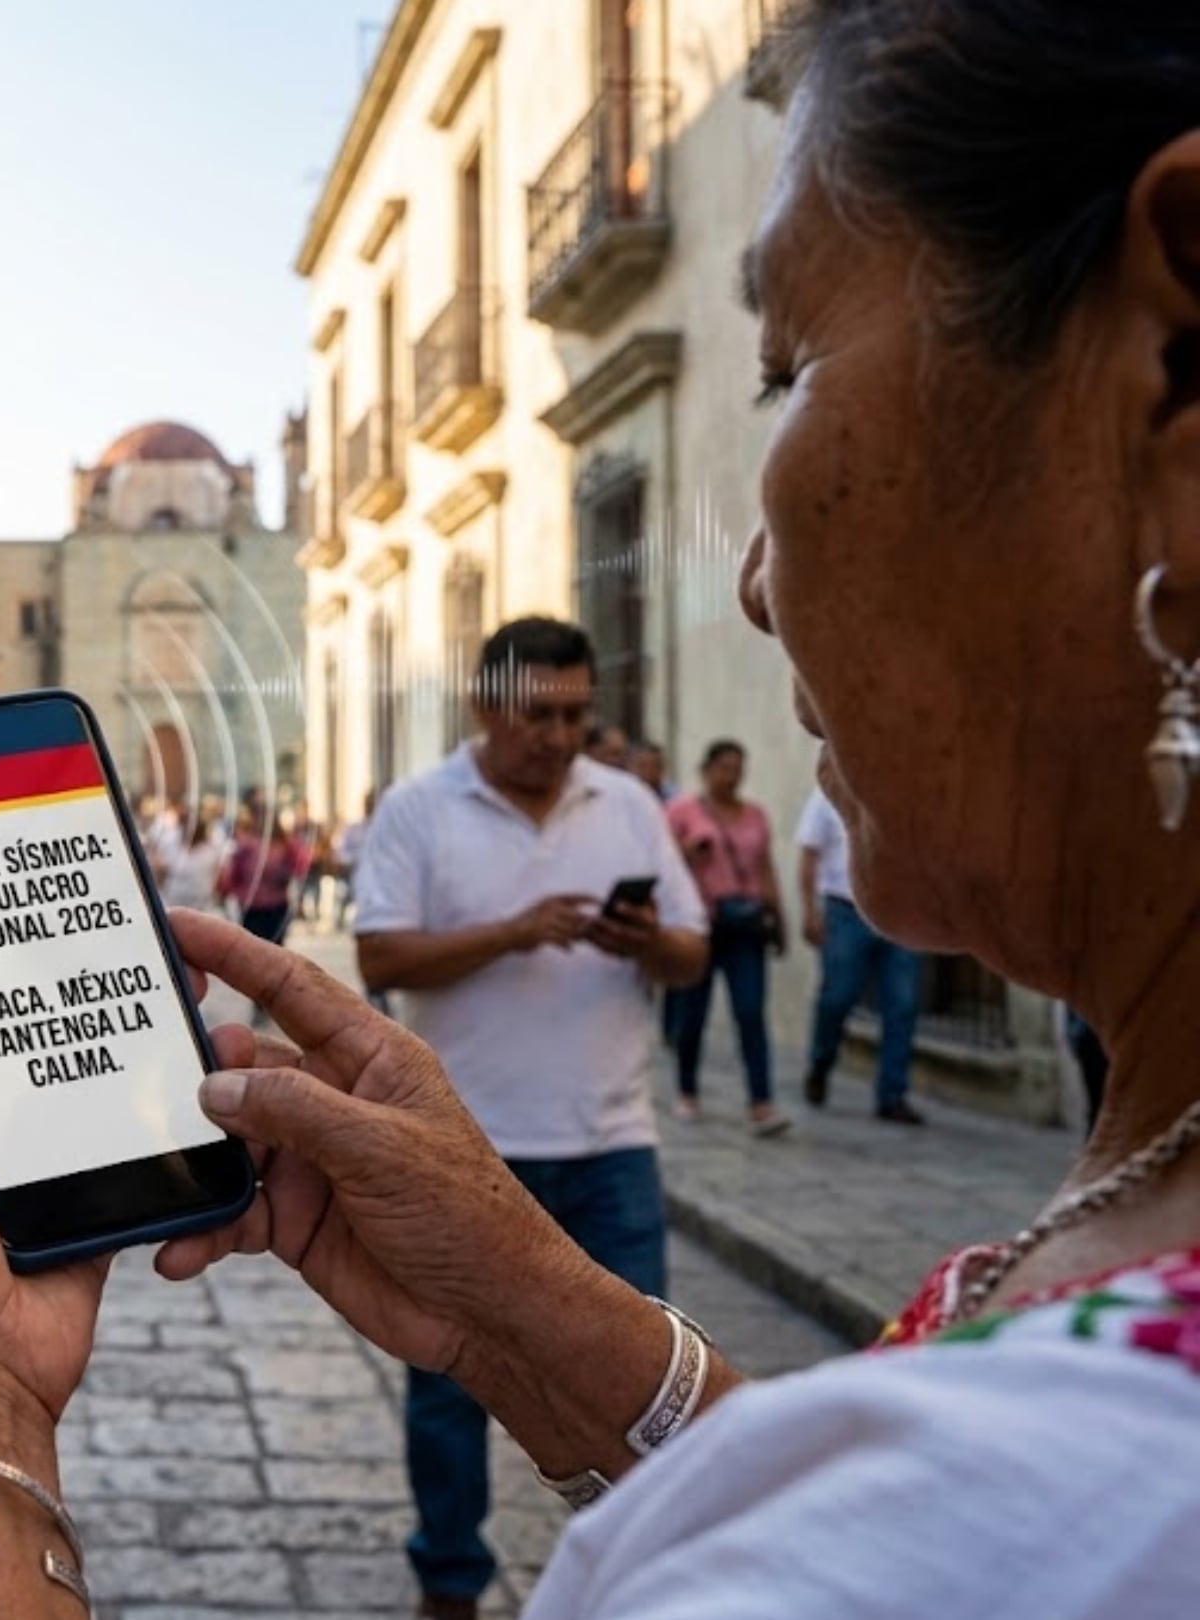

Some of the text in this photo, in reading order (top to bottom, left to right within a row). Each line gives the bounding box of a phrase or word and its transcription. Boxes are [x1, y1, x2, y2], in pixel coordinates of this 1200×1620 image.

[3, 833, 113, 874] SÍSMICA:
[57, 898, 133, 936] 2026.
[56, 964, 161, 1008] MÉXICO.
[117, 1001, 154, 1033] LA
[27, 1045, 125, 1088] CALMA.
